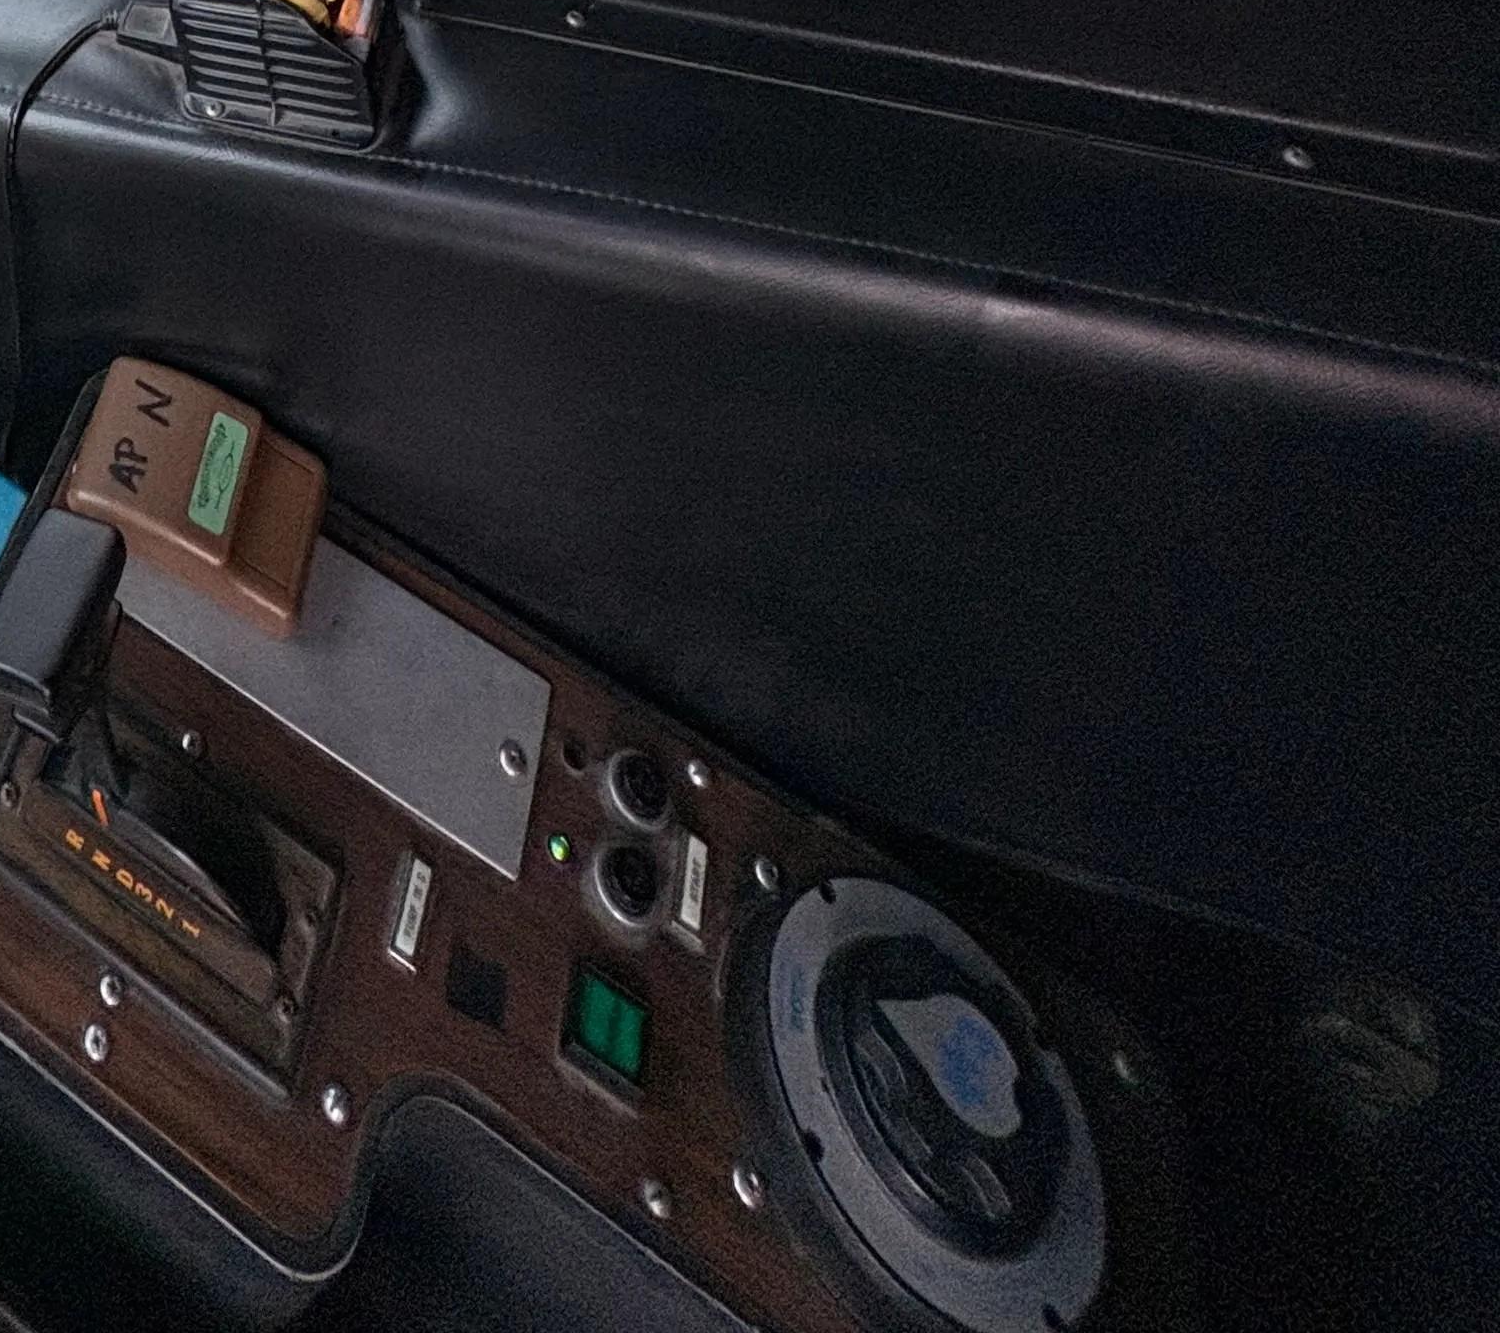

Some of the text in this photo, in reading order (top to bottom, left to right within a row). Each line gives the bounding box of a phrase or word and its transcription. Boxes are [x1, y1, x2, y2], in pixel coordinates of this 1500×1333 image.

[109, 436, 149, 495] AP
[65, 828, 200, 938] R N D 3 2 1
